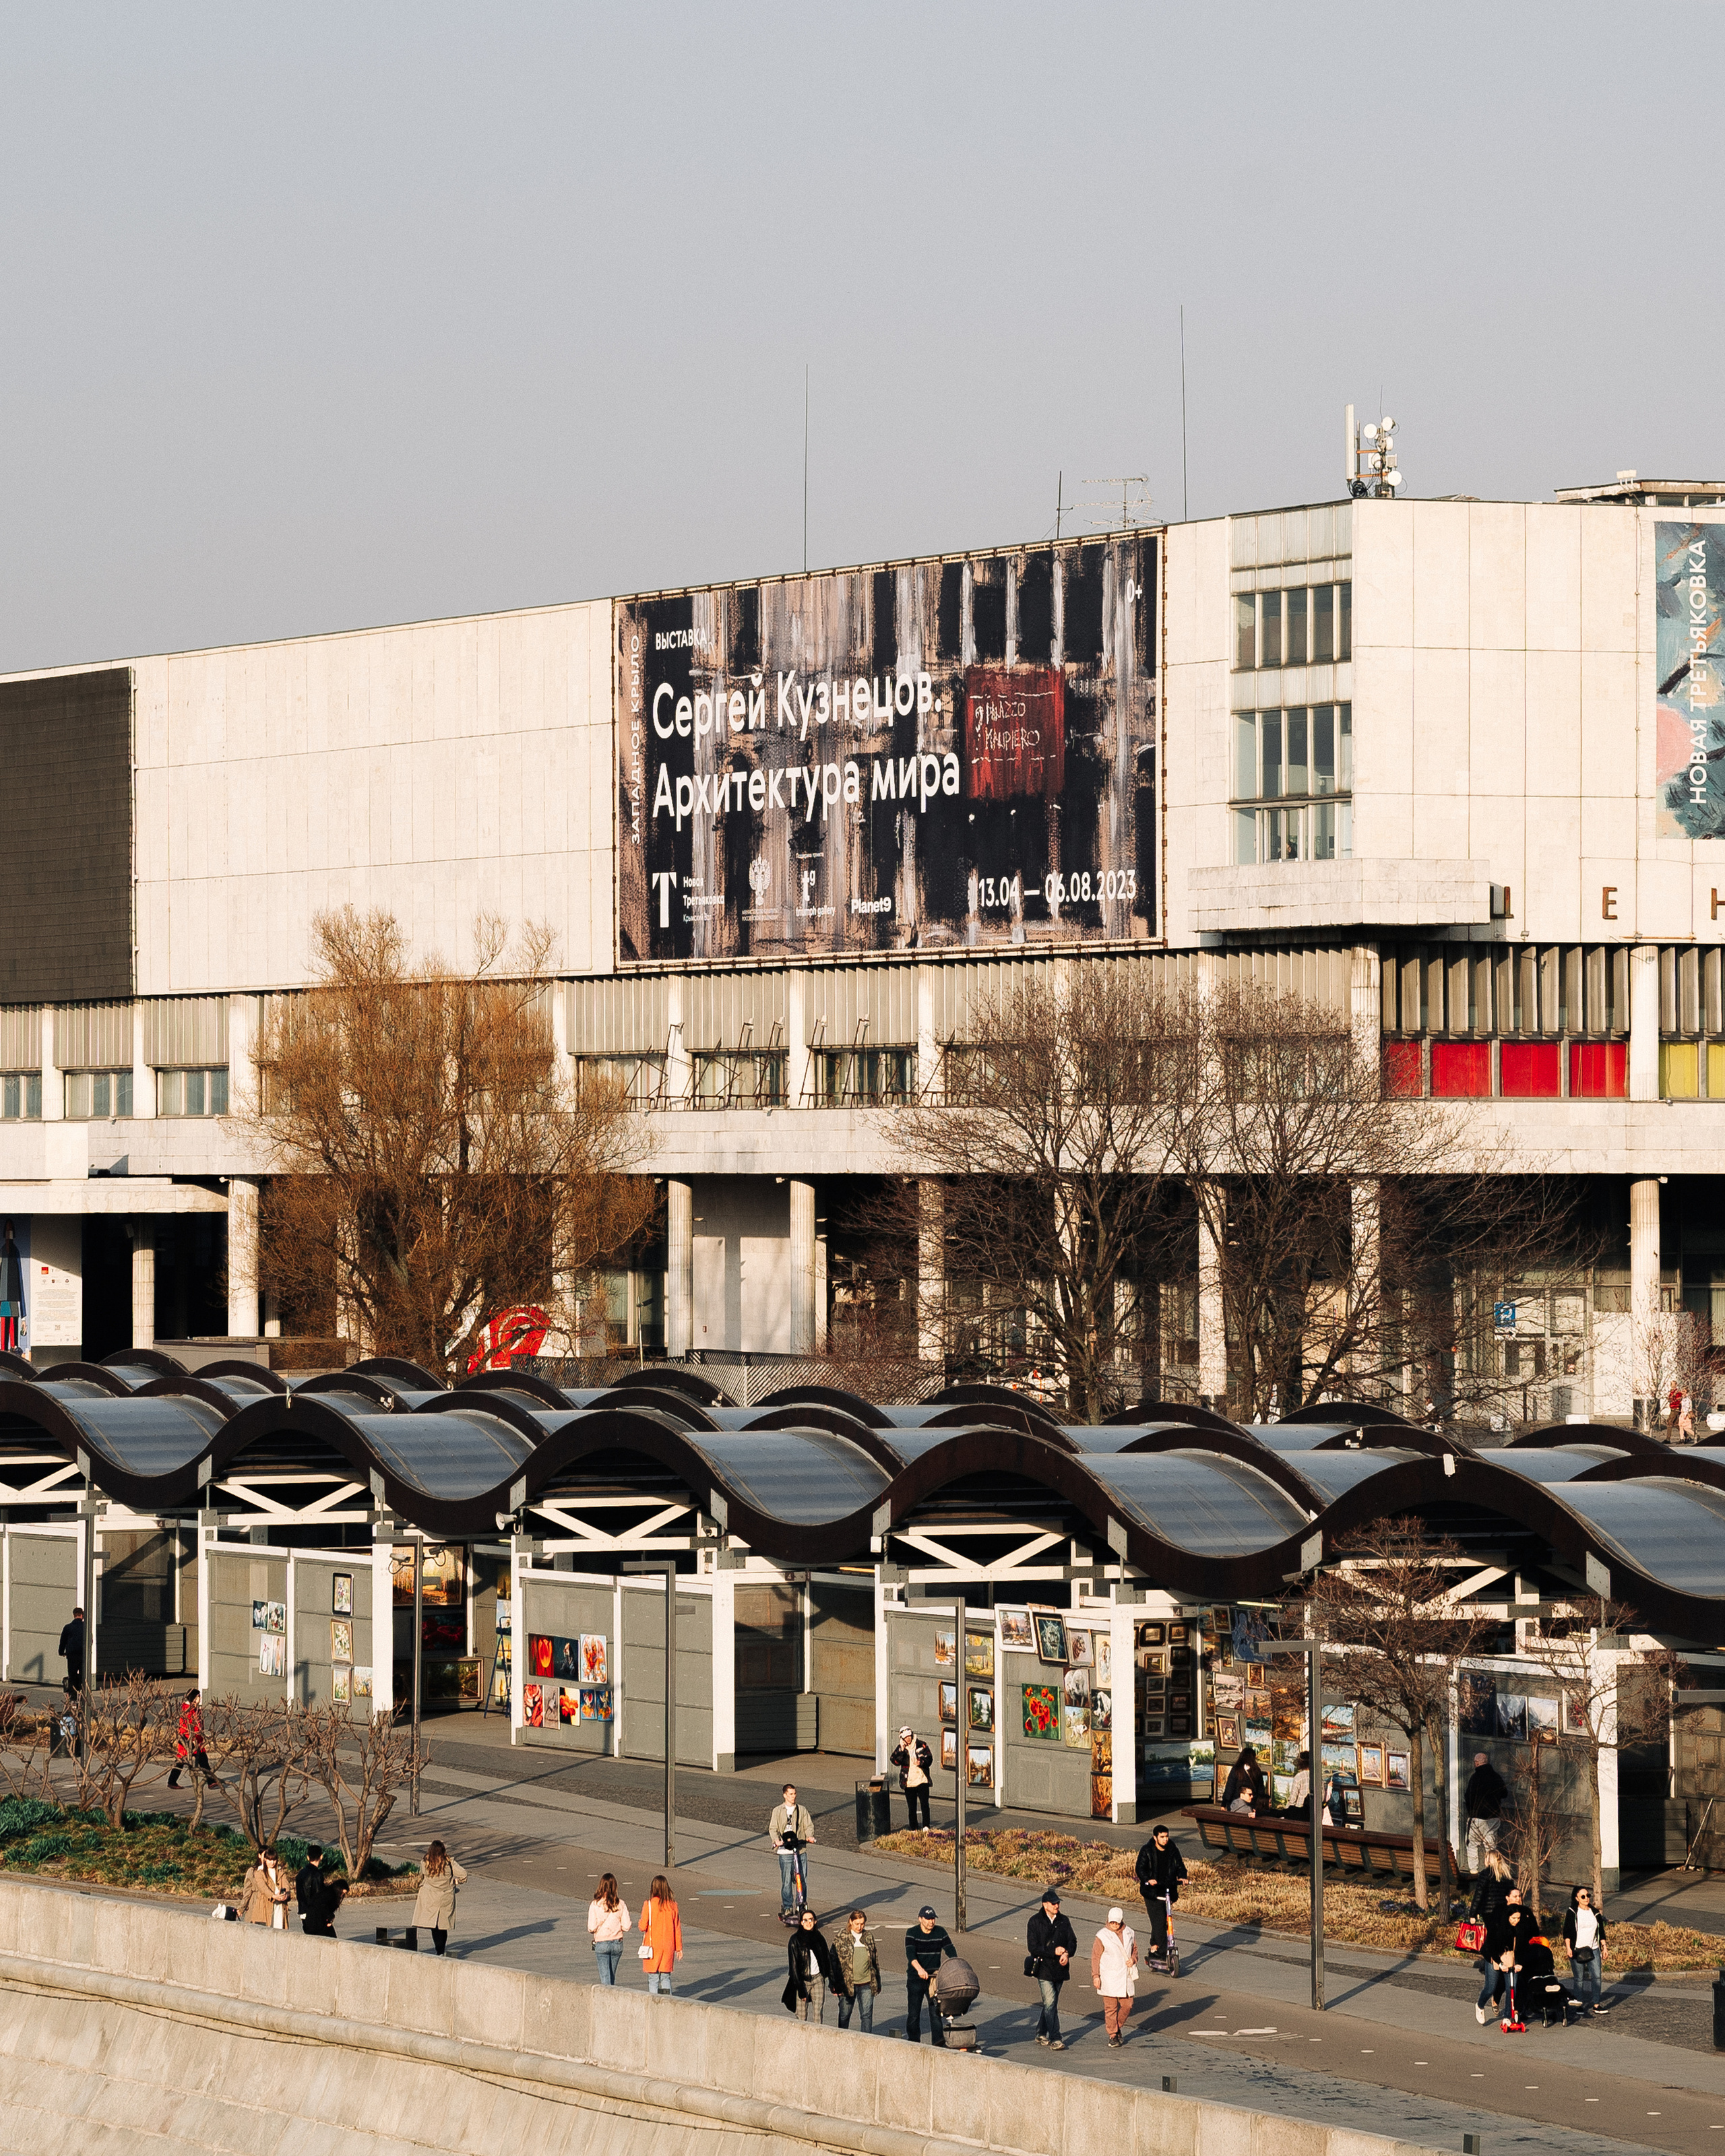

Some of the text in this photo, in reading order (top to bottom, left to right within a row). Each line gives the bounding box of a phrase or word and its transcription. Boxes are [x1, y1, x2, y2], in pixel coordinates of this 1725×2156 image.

[1127, 579, 1143, 603] 0+
[655, 627, 708, 650] ВЫСТАВКА
[1689, 540, 1707, 804] НОВАЯ ТРЕТЬЯКОВКА
[652, 670, 942, 751] Сергей Кузнецов.
[631, 635, 641, 844] ЗАПАДНОЕ КРЫЛО
[652, 752, 960, 832] Архитектура мира
[683, 876, 704, 888] Новая
[978, 876, 1020, 908] 13.04
[1045, 869, 1137, 903] 06.08.2023
[683, 895, 725, 909] Третьяковка
[851, 897, 891, 914] Planet9
